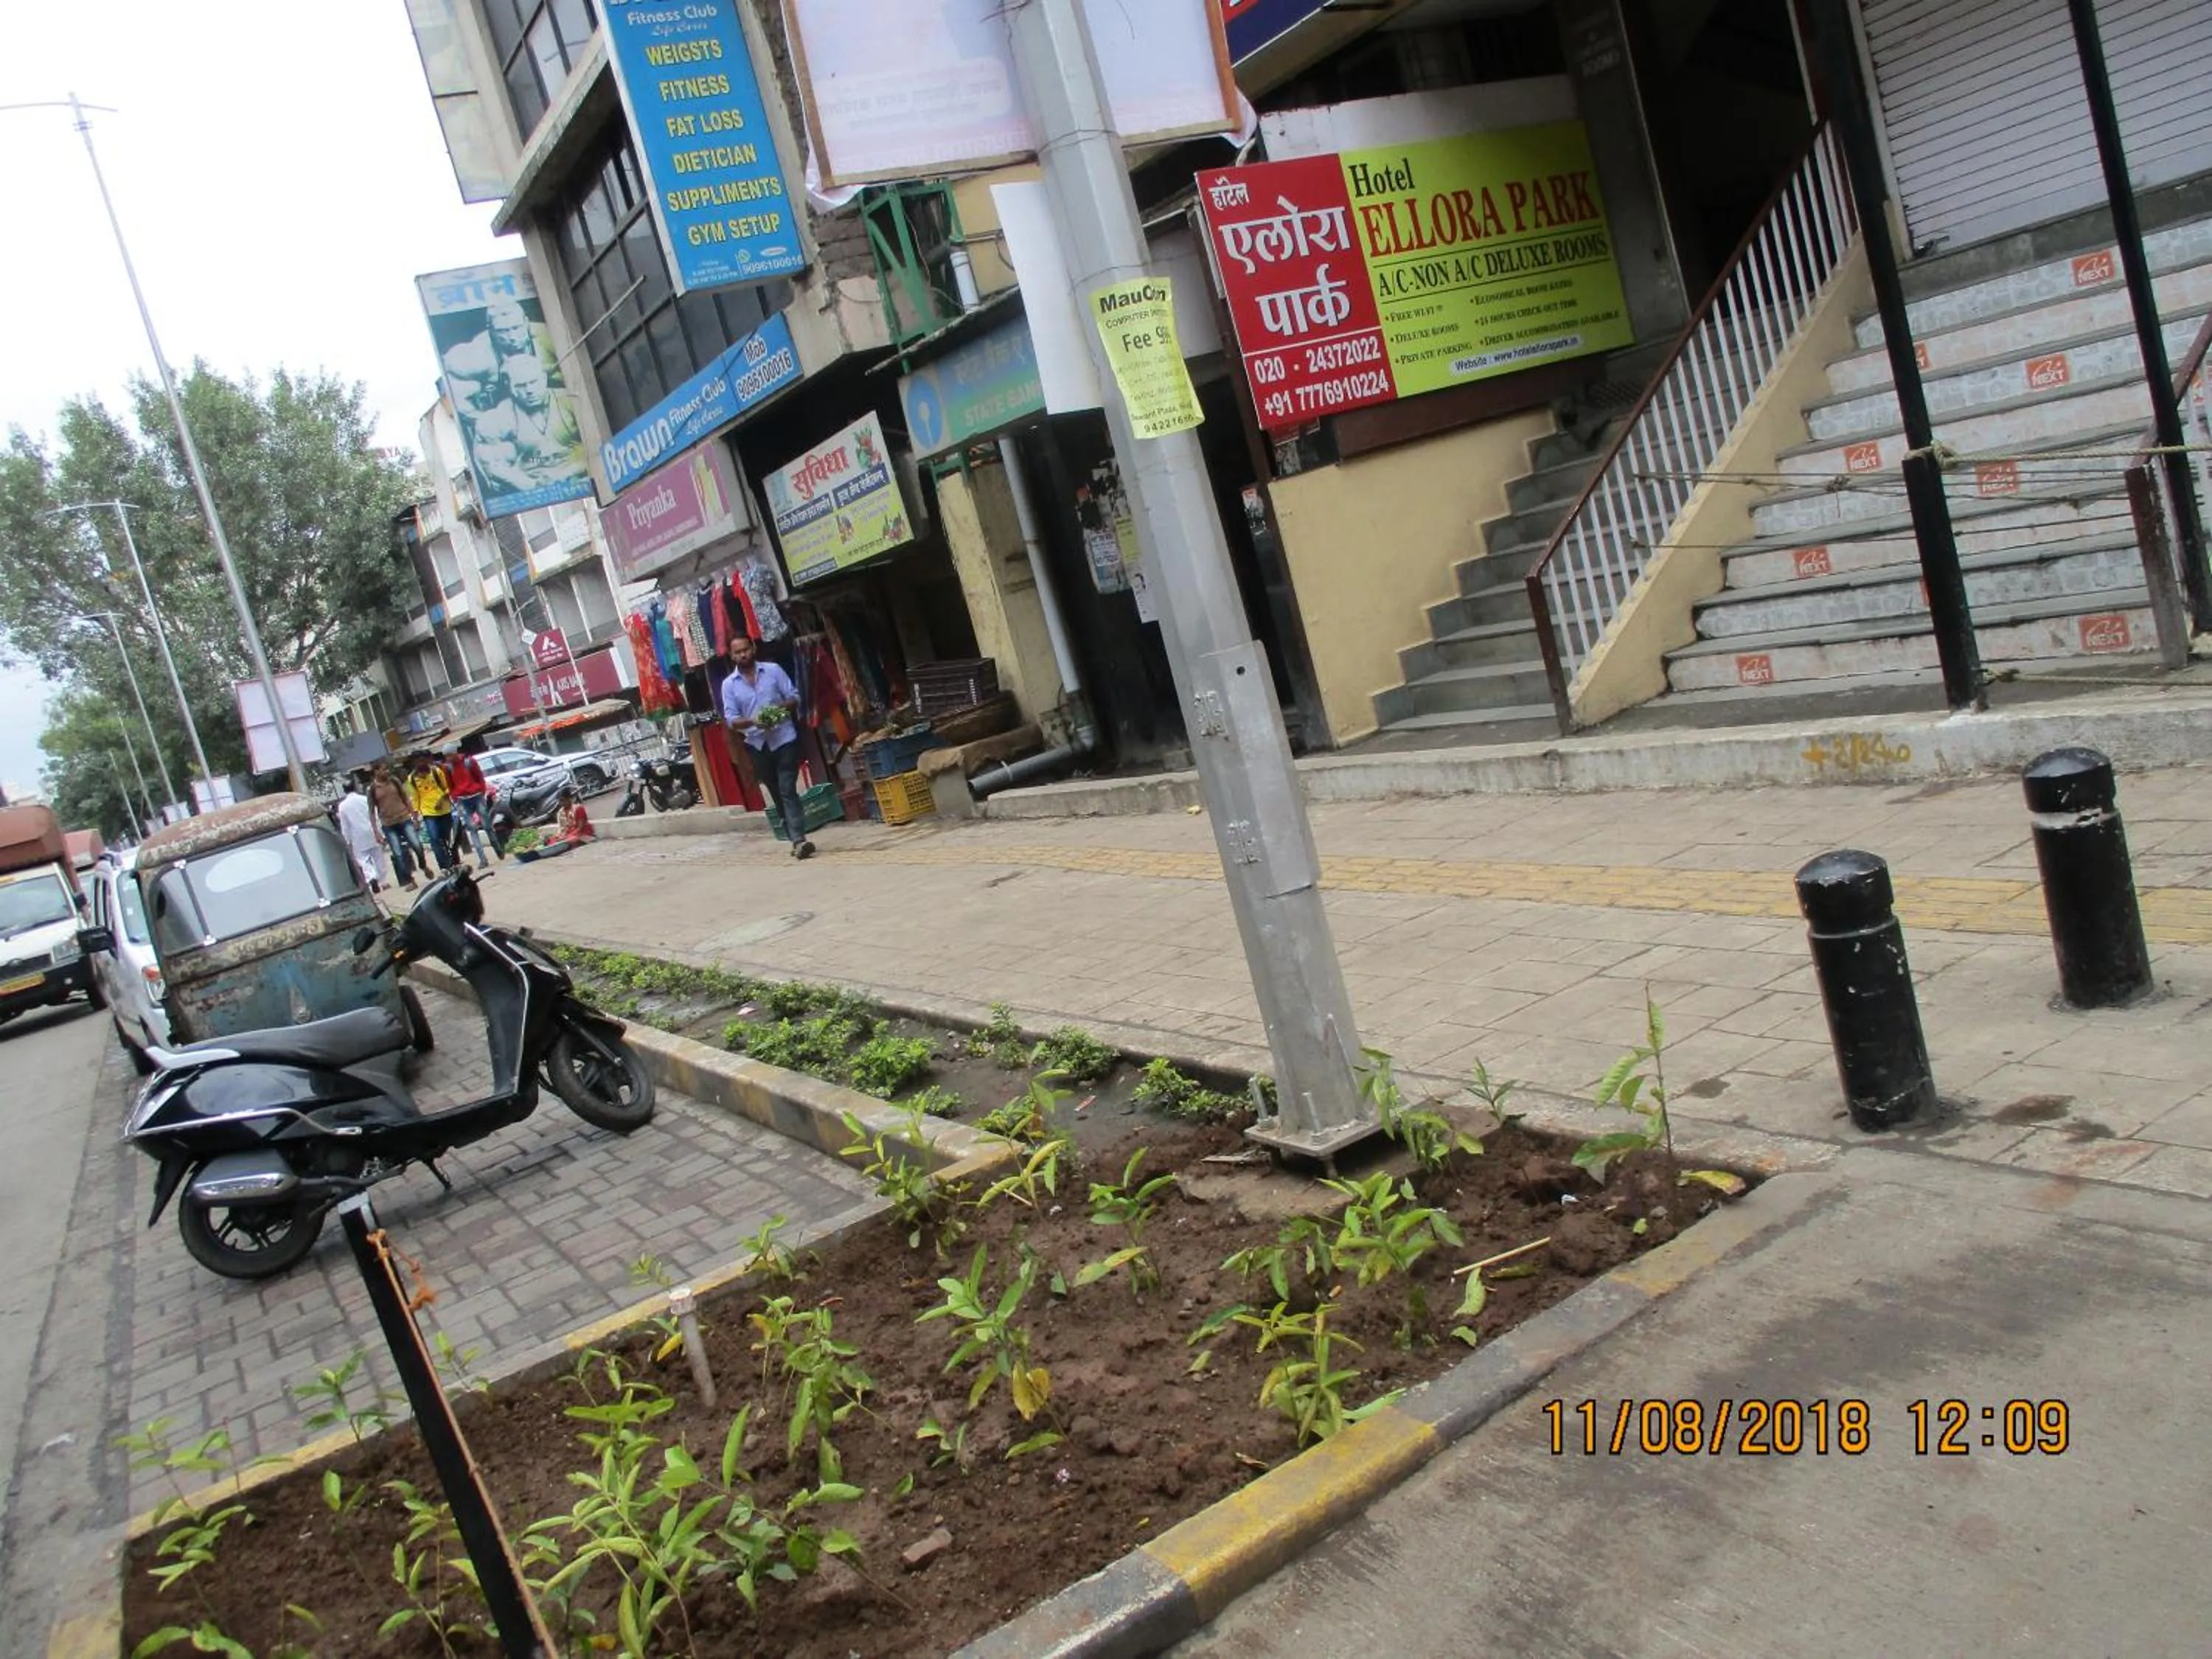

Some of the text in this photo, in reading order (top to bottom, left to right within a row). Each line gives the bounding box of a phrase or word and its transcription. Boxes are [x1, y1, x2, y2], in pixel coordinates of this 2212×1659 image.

[627, 4, 717, 25] Fitness Club
[645, 38, 723, 66] WEIGSTS
[659, 74, 730, 101] FITNESS
[666, 109, 744, 139] FAT LOSS
[672, 143, 757, 174] DIETICIAN
[667, 176, 782, 211] SUPPLIMENTS
[1208, 175, 1250, 211] हॉटेल
[1349, 157, 1415, 198] Hotel
[688, 213, 781, 246] GYM SETUP
[1359, 170, 1600, 258] ELLORA PARK
[1218, 195, 1351, 275] एलोरा
[1454, 255, 1484, 283] A/C
[1486, 241, 1551, 275] DELUXE
[1554, 232, 1609, 262] ROOMS
[2078, 265, 2111, 282] NEXT
[1254, 262, 1351, 337] पार्क
[743, 335, 768, 365] Mob
[1122, 333, 1153, 352] Fee
[735, 347, 794, 402] 9096100016
[1254, 355, 1285, 384] 020
[1306, 335, 1381, 373] 24372022
[1455, 355, 1488, 372] Website
[1264, 369, 1390, 417] +91 7776910224
[2031, 369, 2065, 386] NEXT
[669, 399, 702, 427] Fitness
[701, 376, 726, 403] Club
[790, 445, 850, 501] सुविधा
[1848, 455, 1877, 470] NEXT
[626, 484, 678, 531] Priyanka
[1798, 560, 1828, 574] NEXT
[2085, 630, 2126, 647] NEXT
[1742, 668, 1770, 681] NEXT
